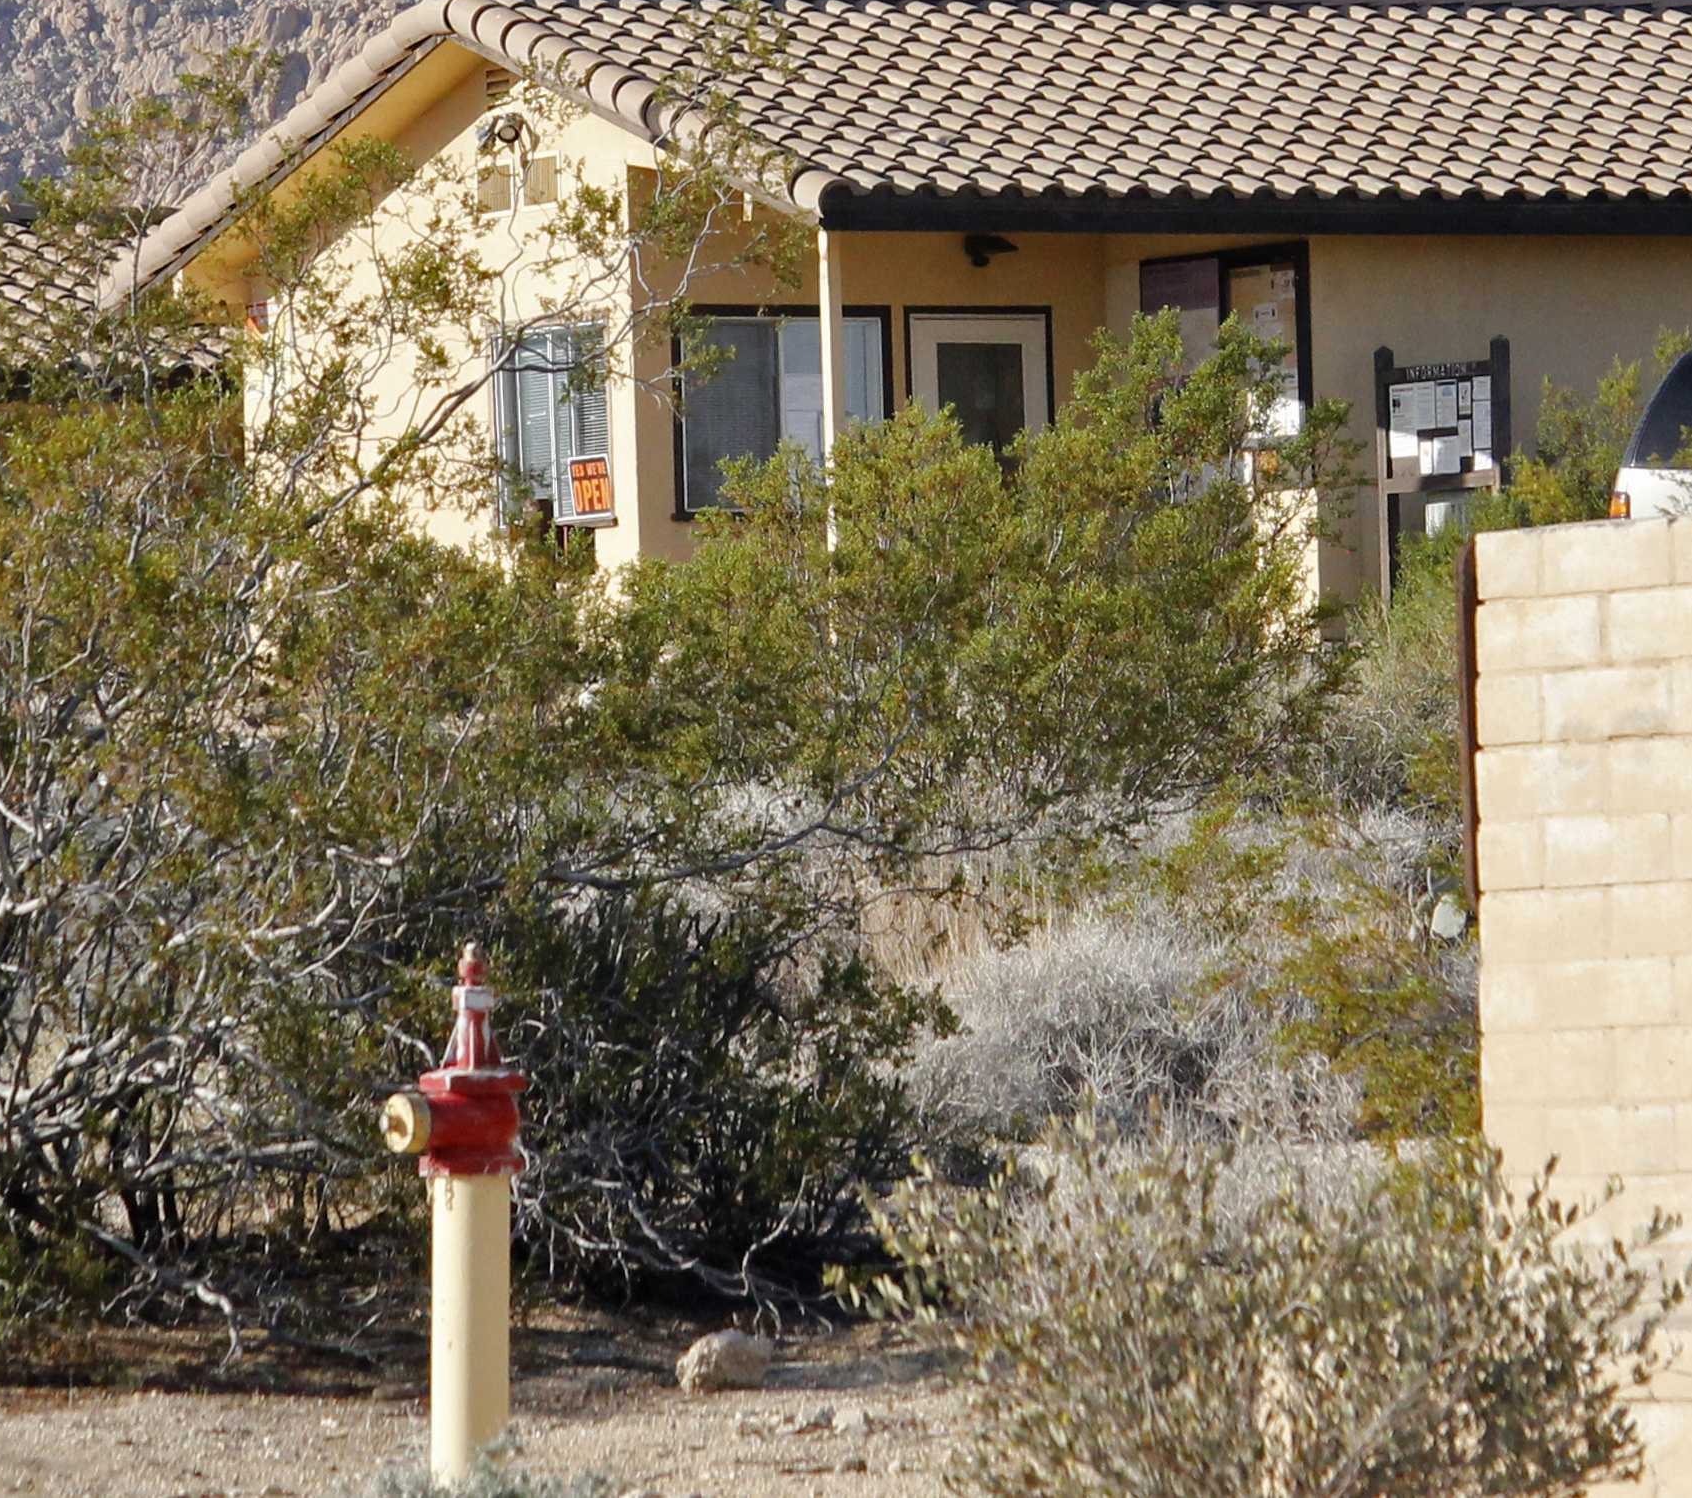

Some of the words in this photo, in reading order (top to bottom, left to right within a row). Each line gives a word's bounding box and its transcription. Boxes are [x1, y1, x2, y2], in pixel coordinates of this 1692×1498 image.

[1406, 363, 1467, 380] INFORMATION
[572, 464, 585, 477] YES
[574, 478, 611, 512] OPEN
